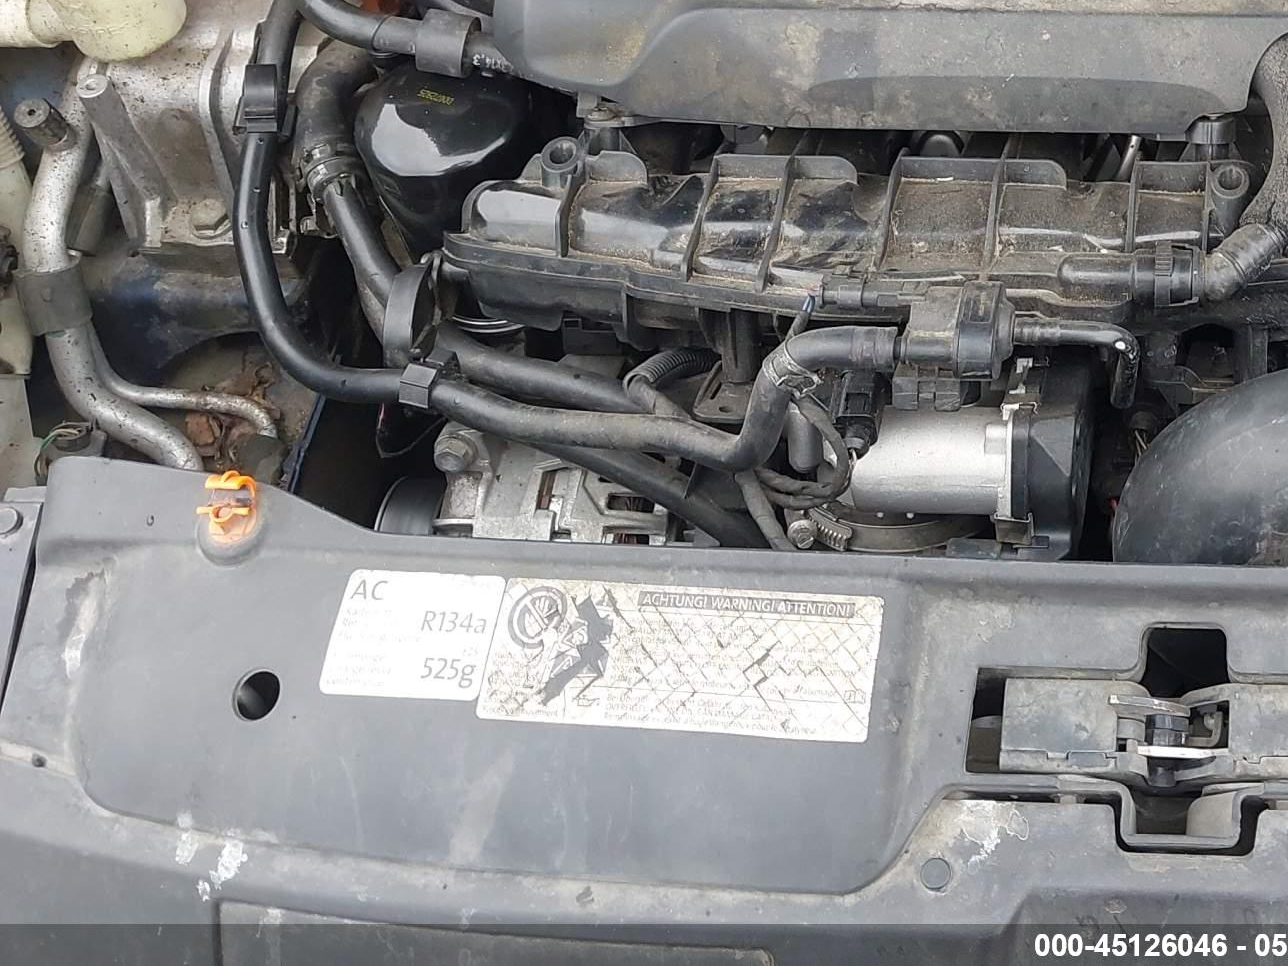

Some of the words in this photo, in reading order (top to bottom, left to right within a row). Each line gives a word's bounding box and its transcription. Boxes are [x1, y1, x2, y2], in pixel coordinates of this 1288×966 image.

[350, 579, 388, 601] AC
[643, 592, 708, 607] ACHTUNG!
[711, 596, 775, 612] WARNING!
[777, 600, 850, 617] ATTENTION!
[420, 610, 487, 633] R134a
[420, 657, 476, 689] 525g
